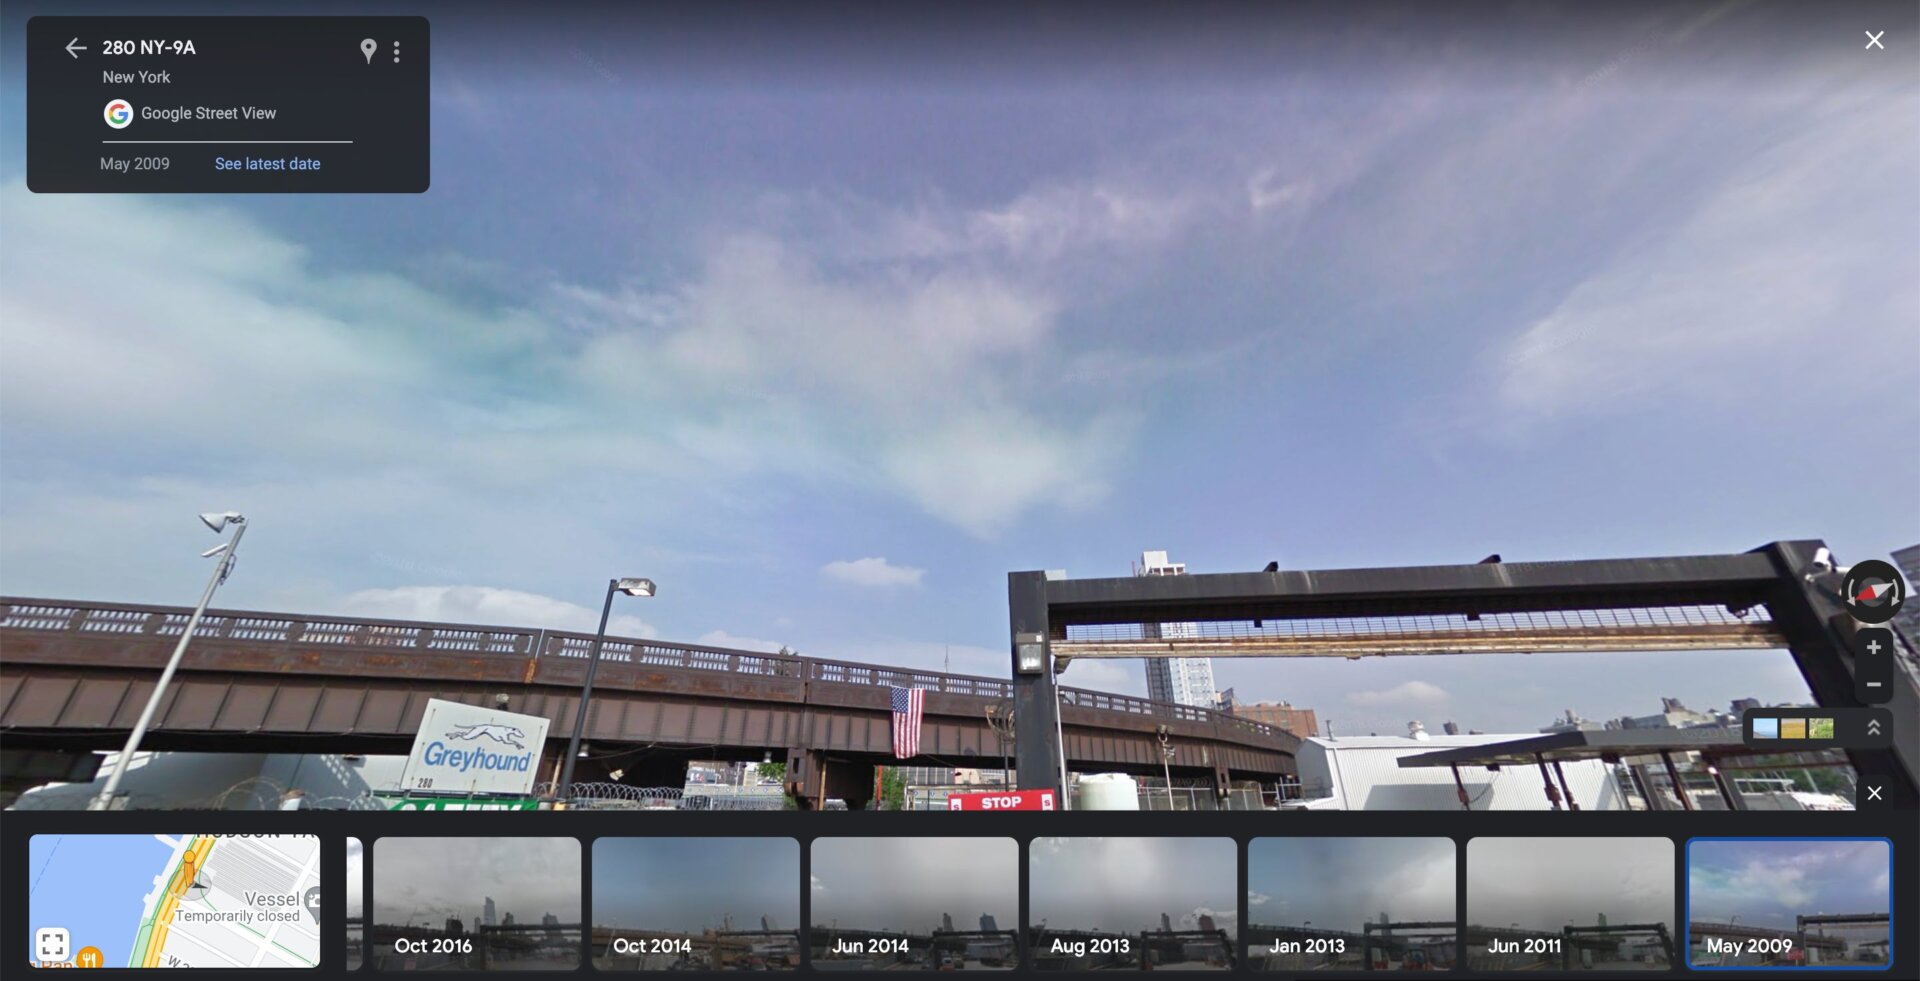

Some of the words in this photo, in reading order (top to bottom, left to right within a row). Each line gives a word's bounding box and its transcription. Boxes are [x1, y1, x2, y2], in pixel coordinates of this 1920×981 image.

[424, 741, 531, 772] Greyhound
[417, 778, 434, 789] 280
[981, 796, 1022, 809] STOP
